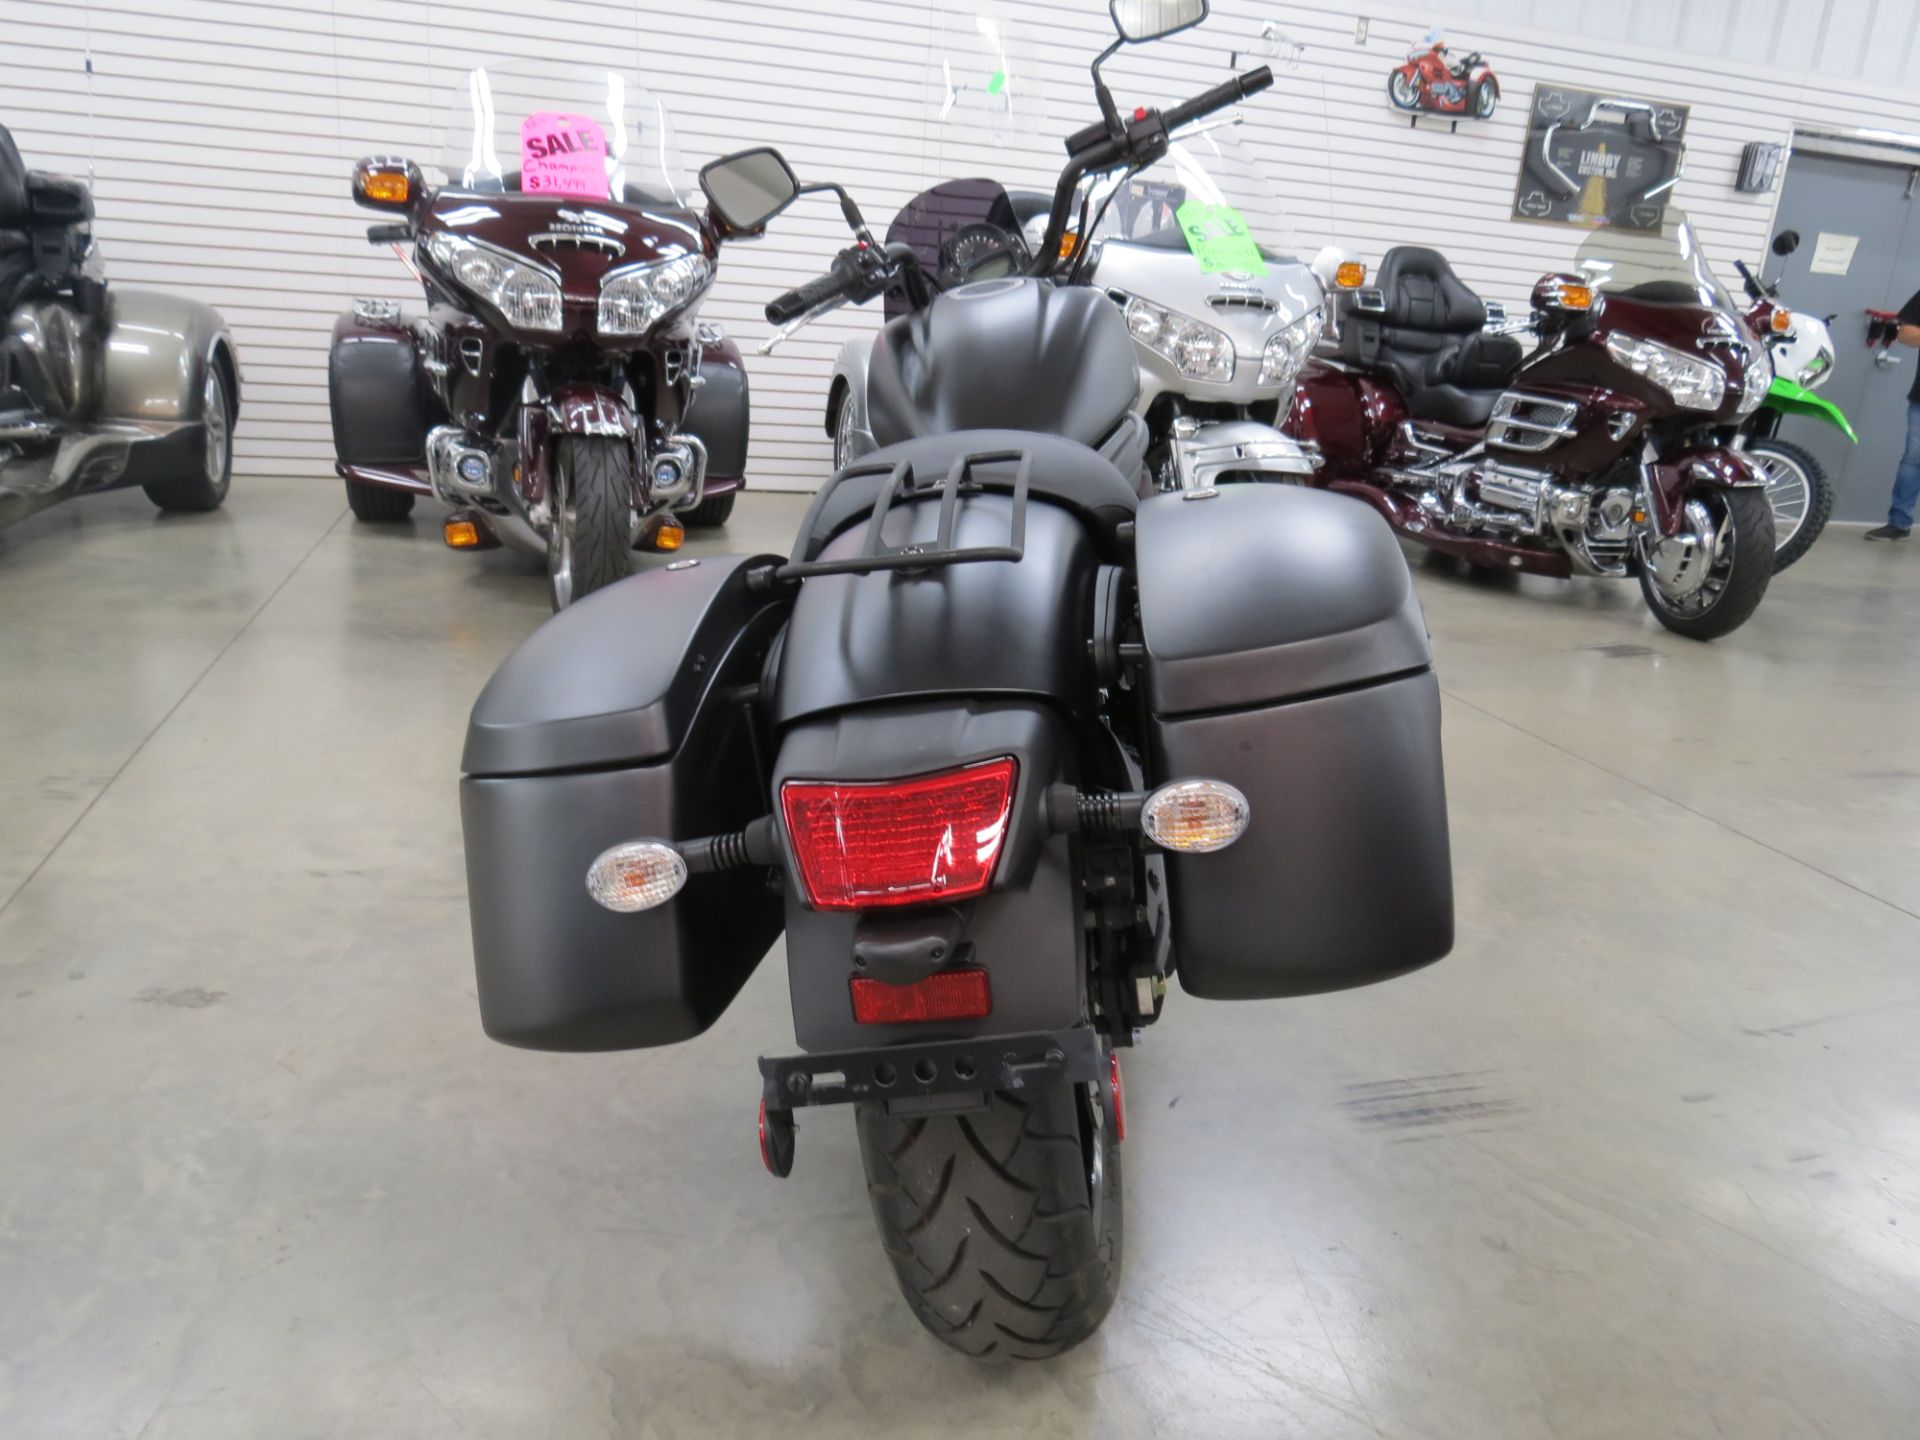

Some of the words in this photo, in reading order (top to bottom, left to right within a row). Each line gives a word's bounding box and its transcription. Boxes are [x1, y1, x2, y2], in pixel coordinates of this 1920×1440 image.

[526, 130, 598, 159] SALE
[1580, 150, 1621, 168] LINDBY
[548, 223, 604, 234] HONDA
